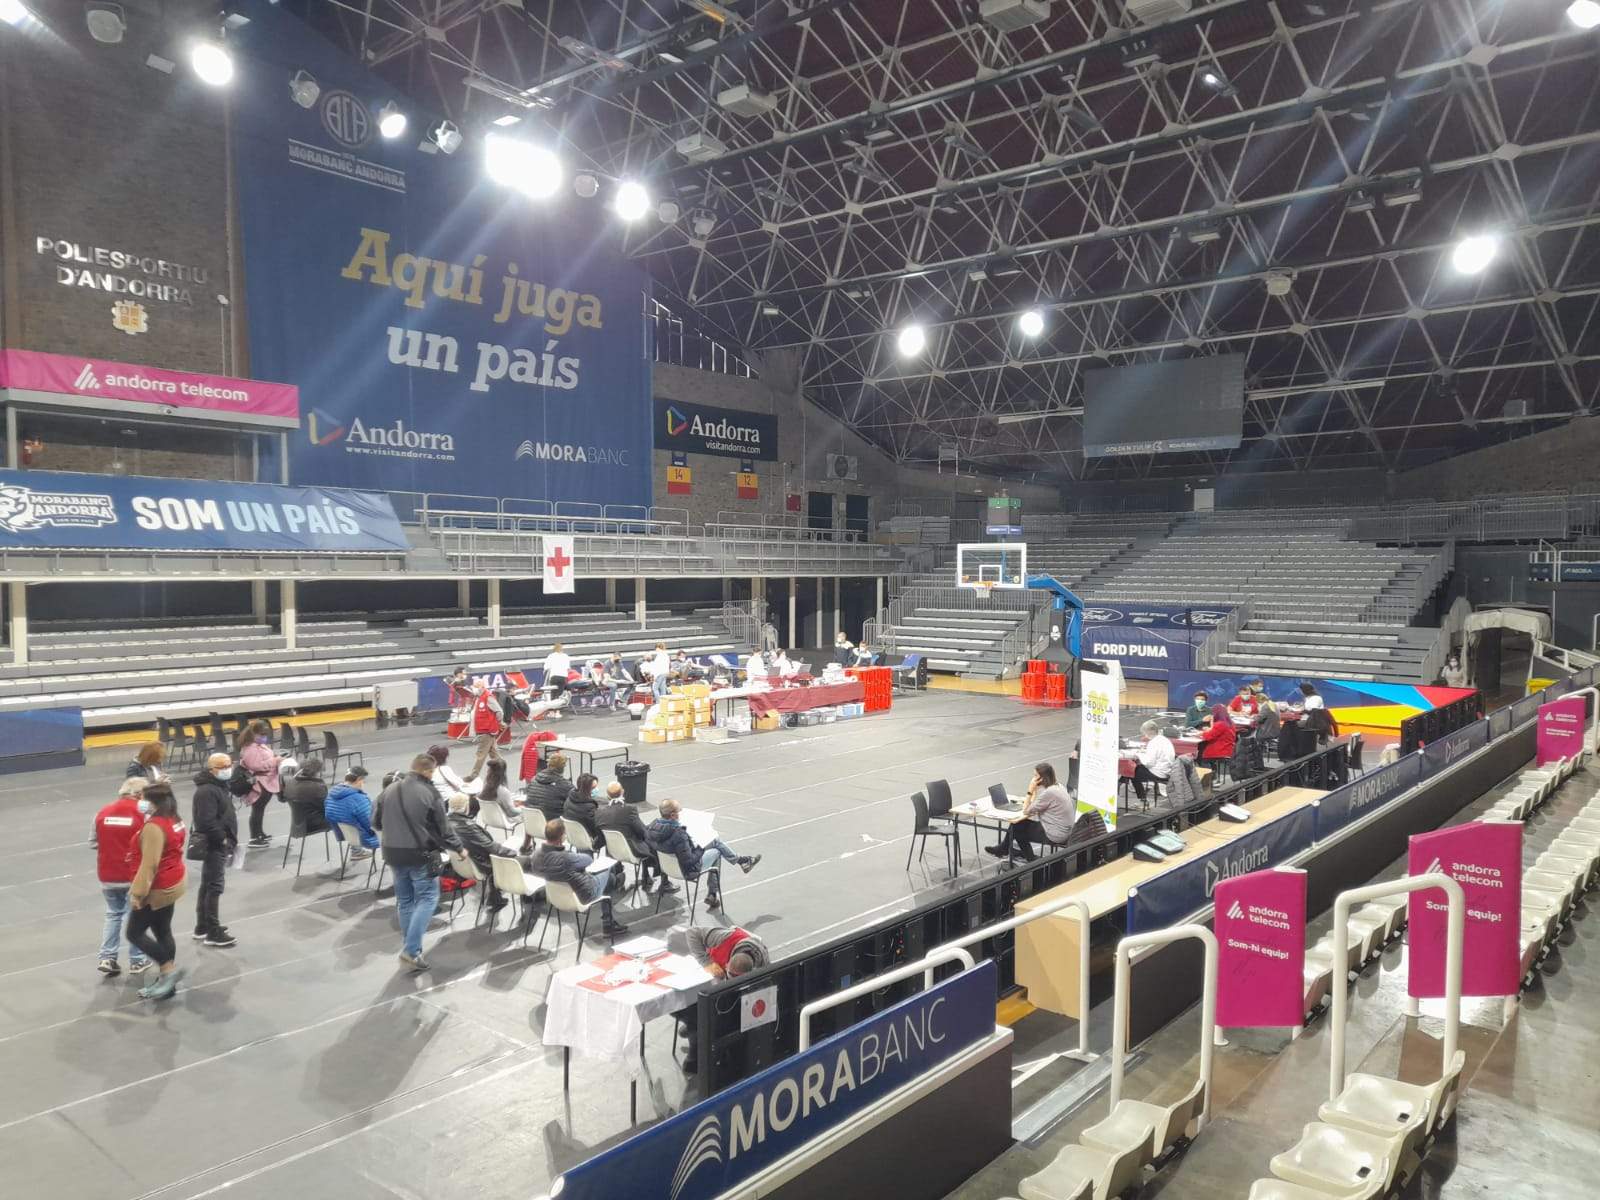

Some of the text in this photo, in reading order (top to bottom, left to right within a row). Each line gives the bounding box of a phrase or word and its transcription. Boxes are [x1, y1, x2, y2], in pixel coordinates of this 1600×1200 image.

[36, 236, 209, 284] POLIESPORTIU
[57, 266, 193, 306] D'ANDORRA
[341, 227, 603, 336] Aquí juga
[387, 326, 580, 392] un país
[105, 373, 249, 402] andorra telecom
[345, 417, 455, 451] Andorra
[690, 414, 761, 443] Andorra
[346, 446, 456, 461] www.visitandorra.com
[705, 440, 761, 455] visitandorra.com
[30, 495, 109, 506] MORABANC
[34, 504, 114, 519] ANDORRA
[131, 496, 360, 535] SOM UN PAÍS
[1093, 642, 1168, 658] FORD PUMA
[1221, 845, 1269, 881] Andorra
[1452, 862, 1501, 877] andorra
[1452, 872, 1503, 888] telecom
[1249, 904, 1288, 920] andorra
[1249, 913, 1291, 931] telecom
[1467, 909, 1502, 922] equip!
[1227, 938, 1289, 960] Som-hi equip!
[729, 997, 946, 1160] MORABANC
